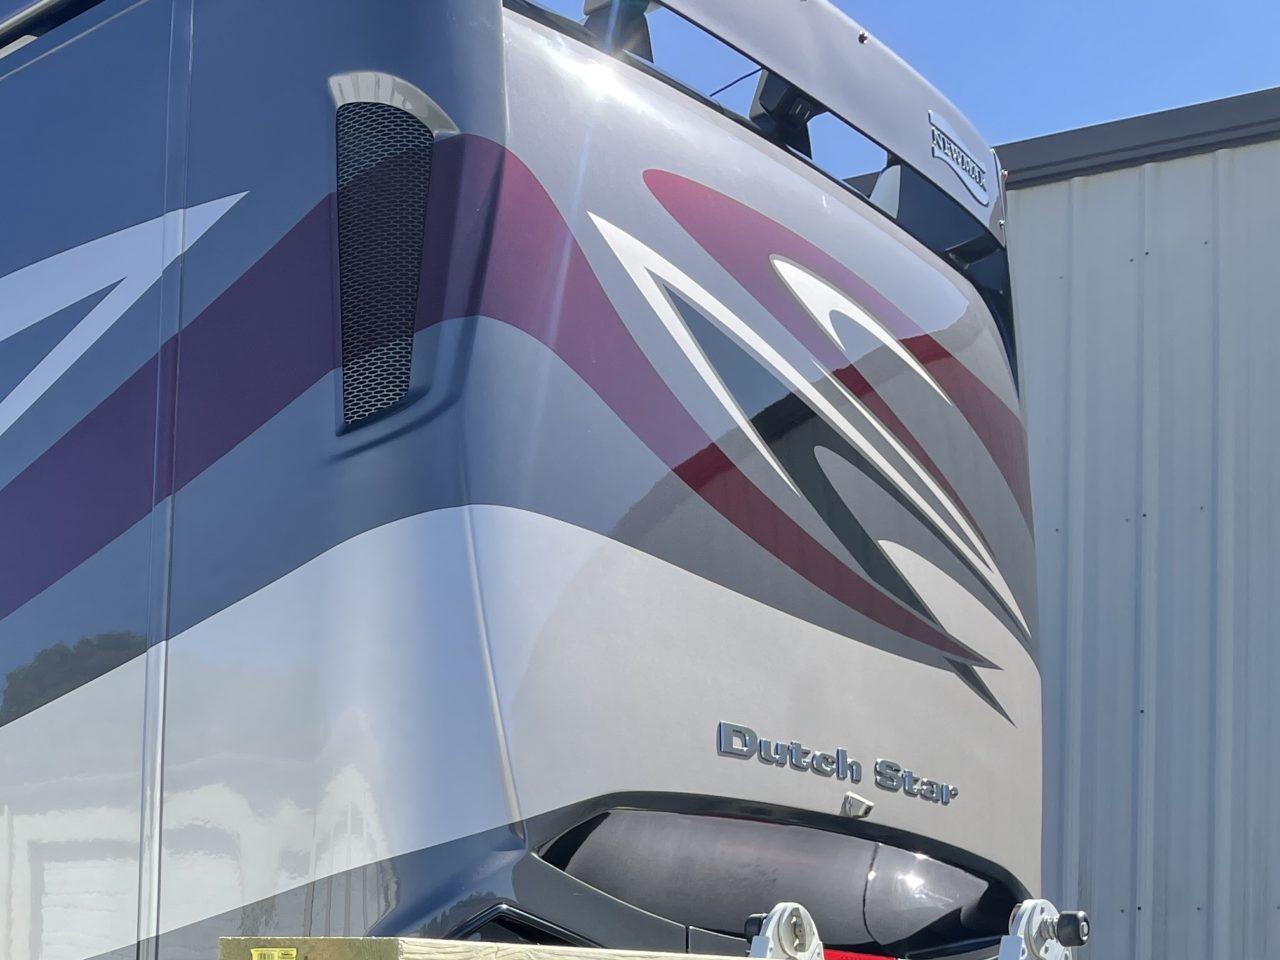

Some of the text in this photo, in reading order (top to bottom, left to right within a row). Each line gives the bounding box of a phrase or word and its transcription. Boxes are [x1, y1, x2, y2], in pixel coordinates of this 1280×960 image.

[931, 127, 987, 192] NEWMAR
[717, 720, 959, 806] Dutch Star
